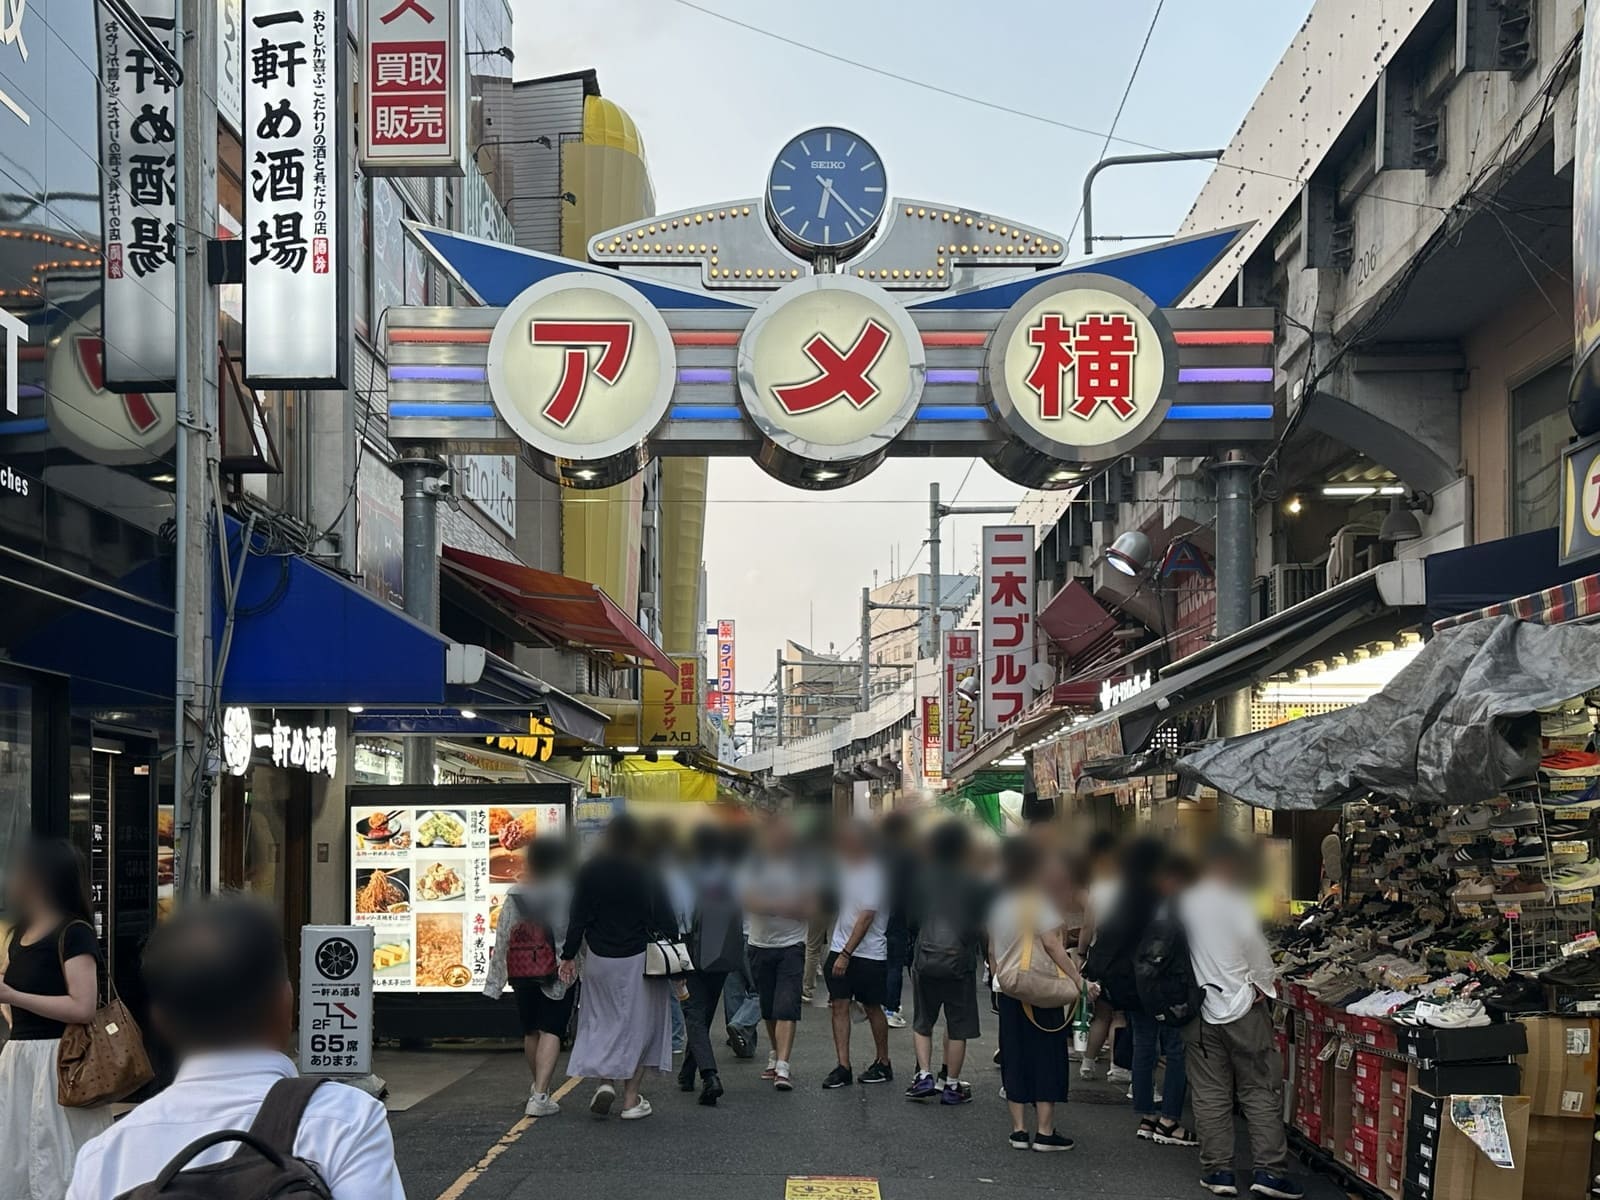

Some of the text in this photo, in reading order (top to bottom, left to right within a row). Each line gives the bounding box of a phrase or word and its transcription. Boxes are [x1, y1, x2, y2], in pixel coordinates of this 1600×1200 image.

[376, 52, 443, 87] 買取
[313, 9, 326, 236] おやじが喜ぶこだわりの酒と肴だけの店
[375, 104, 443, 140] 販売
[250, 9, 308, 275] 一軒め酒場
[811, 160, 846, 169] SEIKO
[1358, 243, 1377, 288] 206
[991, 533, 1029, 723] 二木ゴルフ
[680, 662, 695, 705] 御徒町
[662, 687, 677, 731] プラザ
[254, 718, 338, 779] 一軒め酒場
[669, 731, 691, 742] 入口
[478, 810, 487, 834] ちくわ
[312, 1019, 331, 1030] 2F
[310, 1055, 358, 1067] あります。
[311, 1034, 359, 1053] 65席
